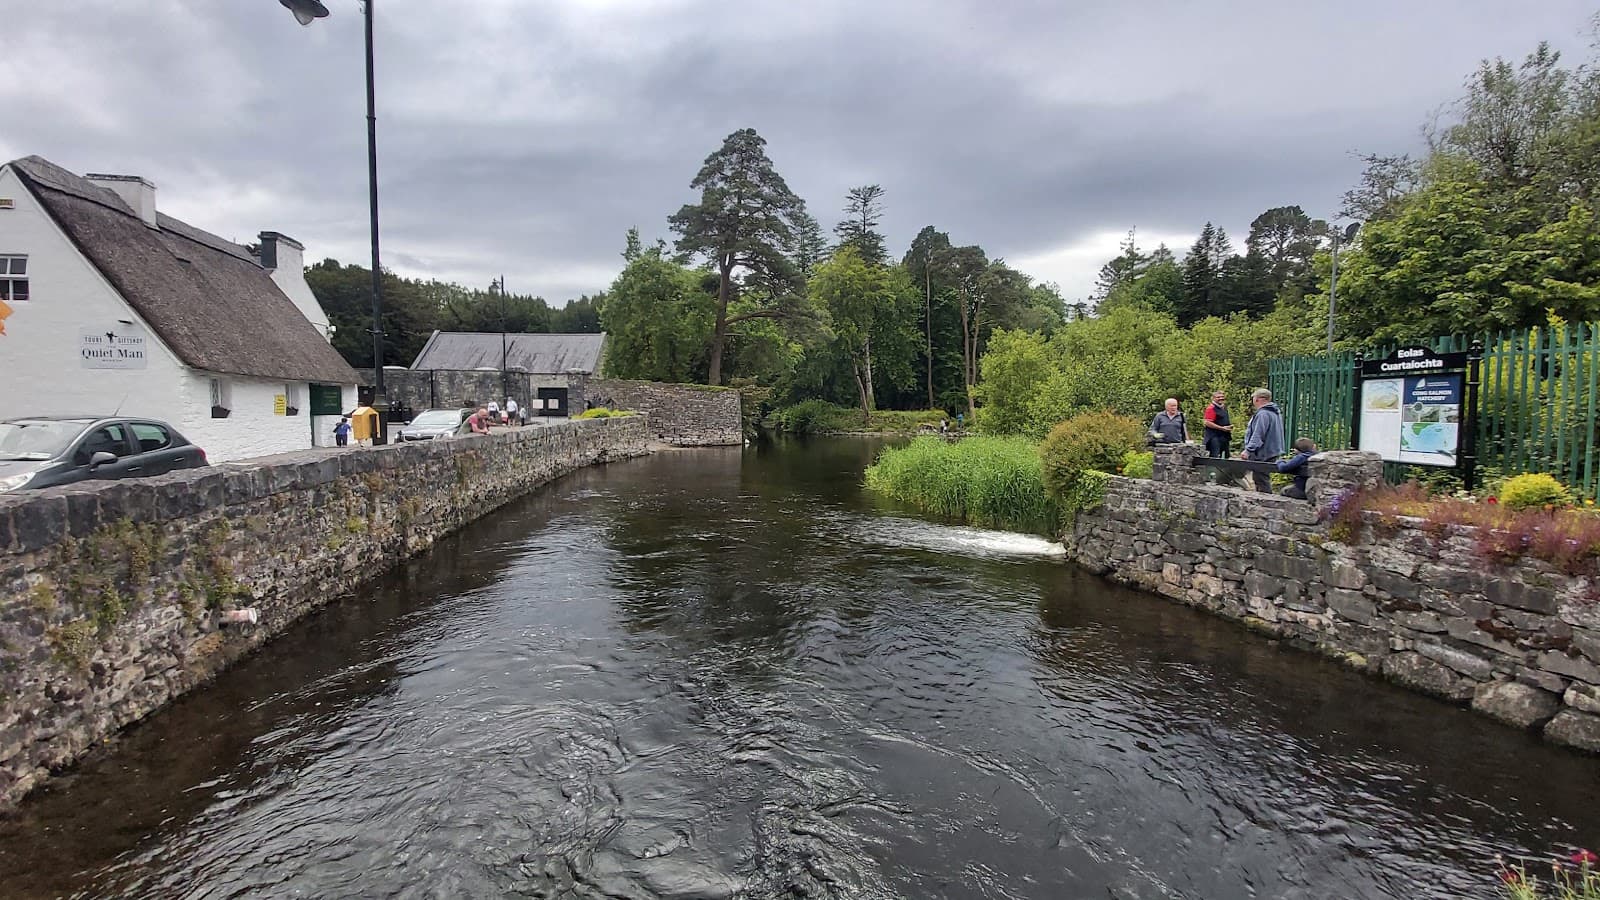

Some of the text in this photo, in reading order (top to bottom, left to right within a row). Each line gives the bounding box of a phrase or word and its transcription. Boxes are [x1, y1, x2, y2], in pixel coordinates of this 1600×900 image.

[82, 348, 143, 359] Quiet Man
[1398, 348, 1424, 358] Eolas
